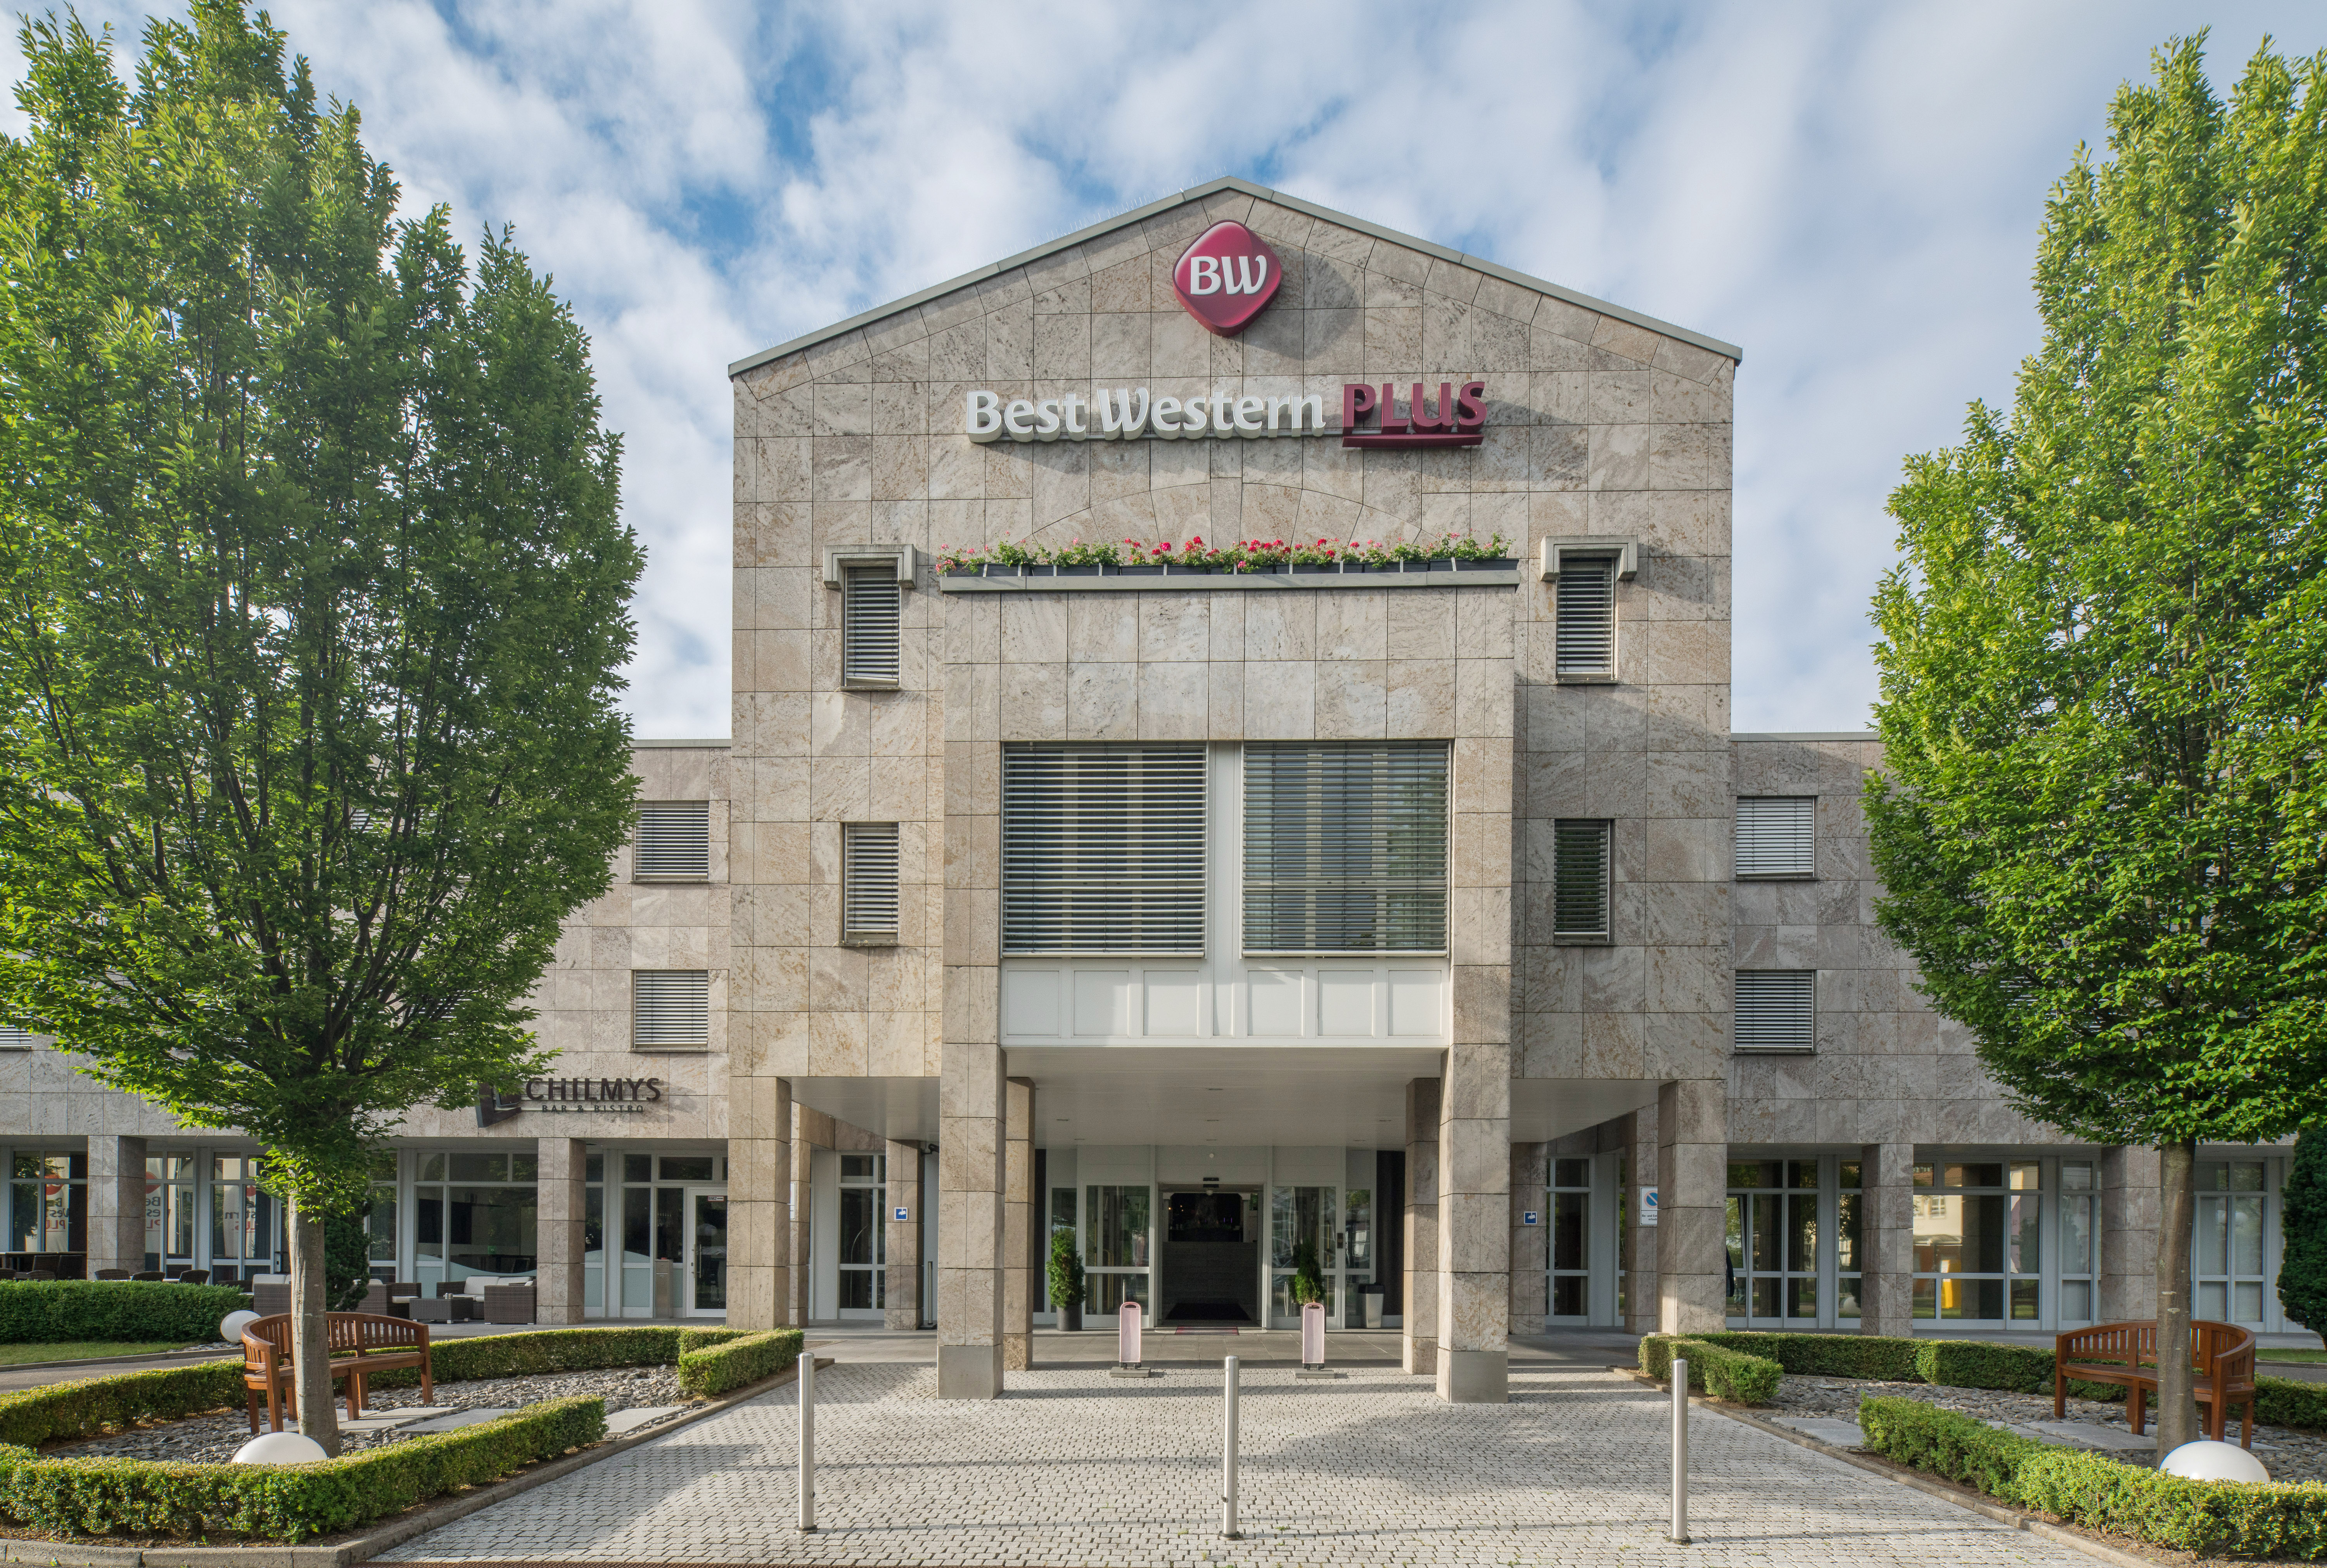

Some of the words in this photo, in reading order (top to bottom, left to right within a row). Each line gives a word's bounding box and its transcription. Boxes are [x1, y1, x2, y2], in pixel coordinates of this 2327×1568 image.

[1190, 255, 1267, 295] BW
[967, 389, 1087, 442] Best
[1097, 387, 1326, 440] Western
[1343, 382, 1485, 435] PLUS
[526, 1077, 661, 1101] CHILMYS
[542, 1105, 567, 1113] BAR
[577, 1105, 584, 1113] &
[594, 1105, 643, 1113] BISTRO
